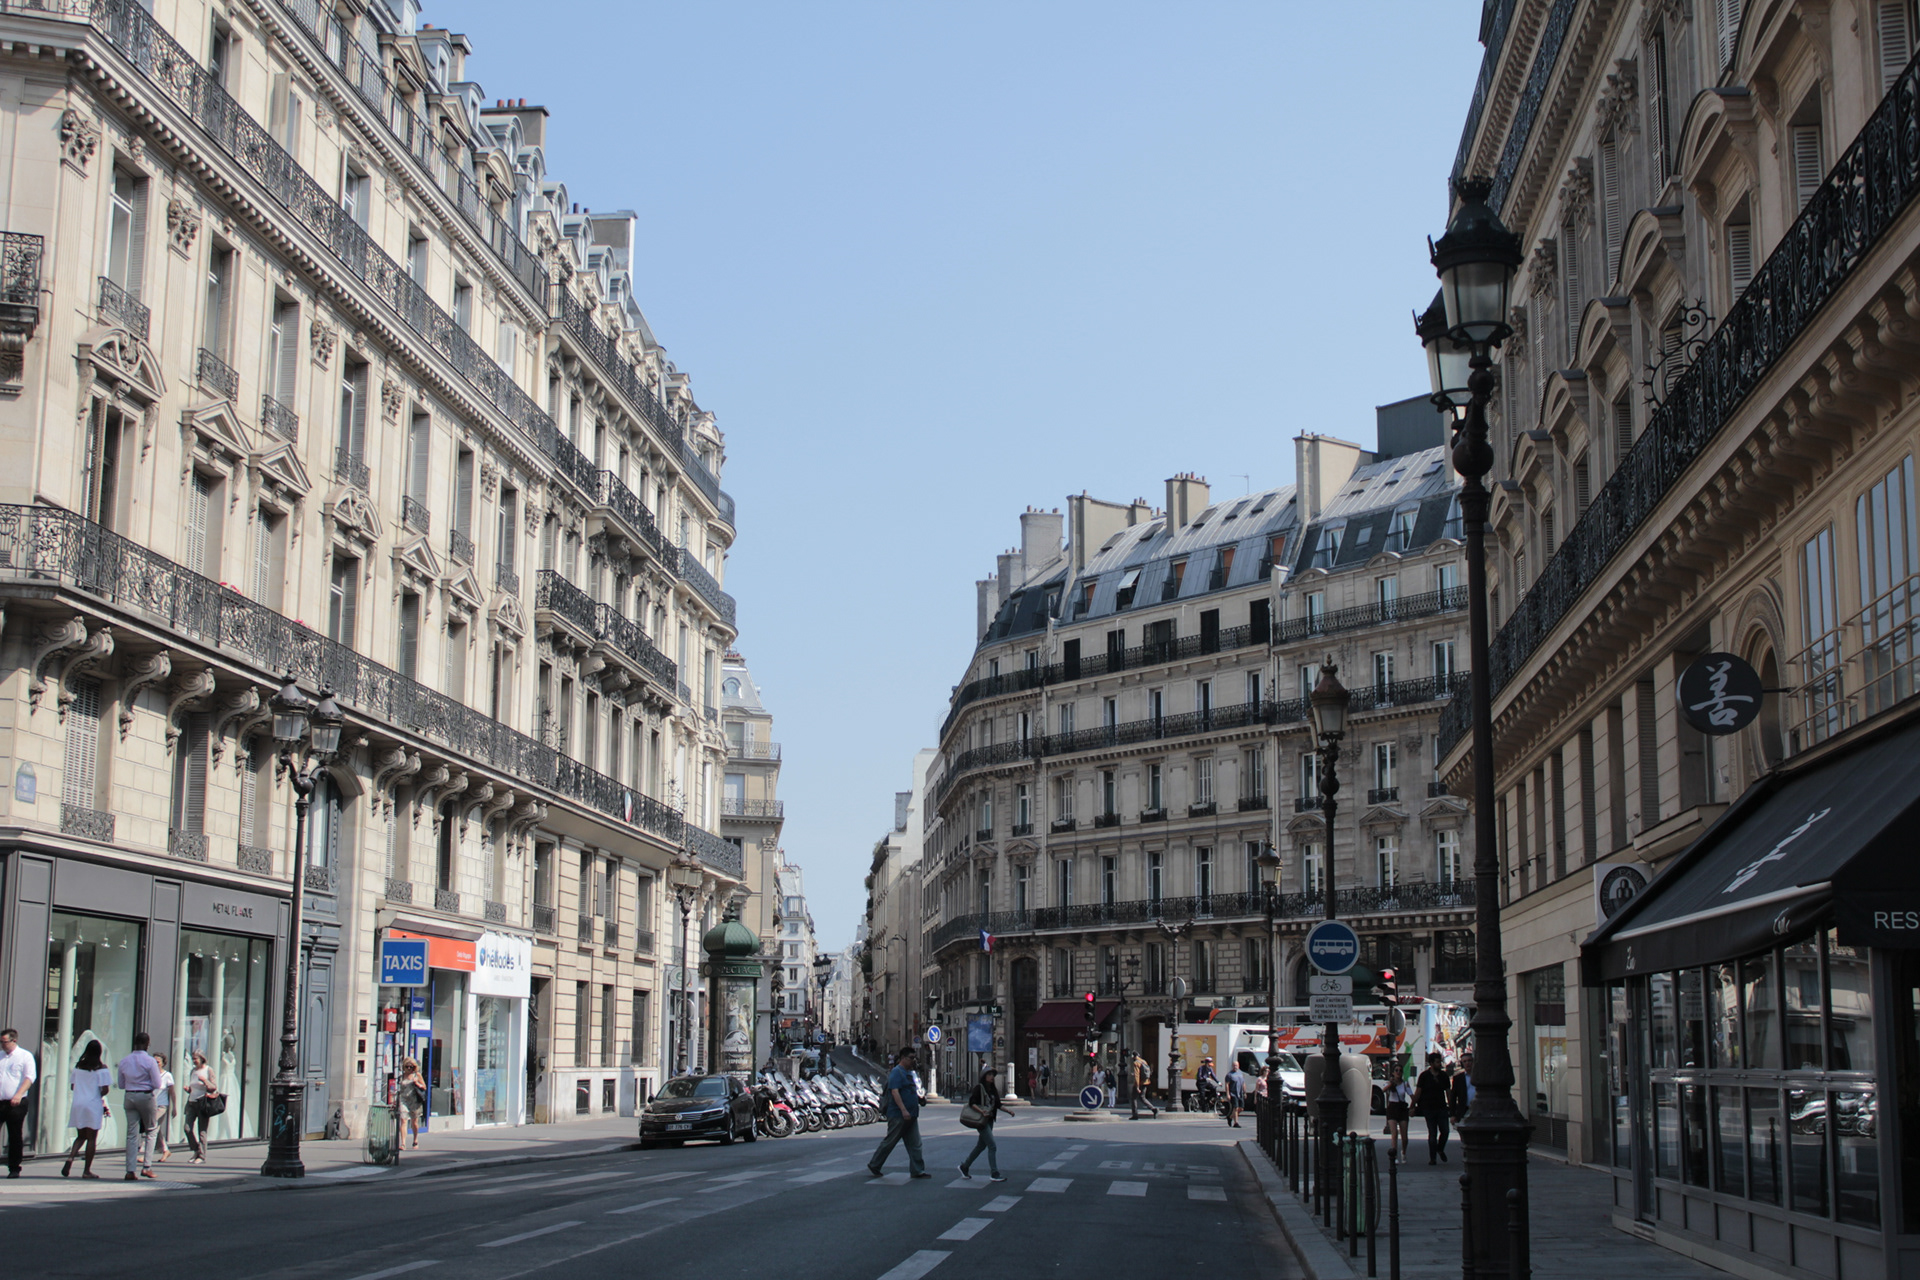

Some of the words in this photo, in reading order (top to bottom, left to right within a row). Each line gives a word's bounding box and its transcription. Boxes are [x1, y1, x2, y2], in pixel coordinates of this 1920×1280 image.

[1874, 911, 1920, 929] RES
[384, 955, 423, 971] TAXIS
[1098, 1160, 1220, 1175] BUS
